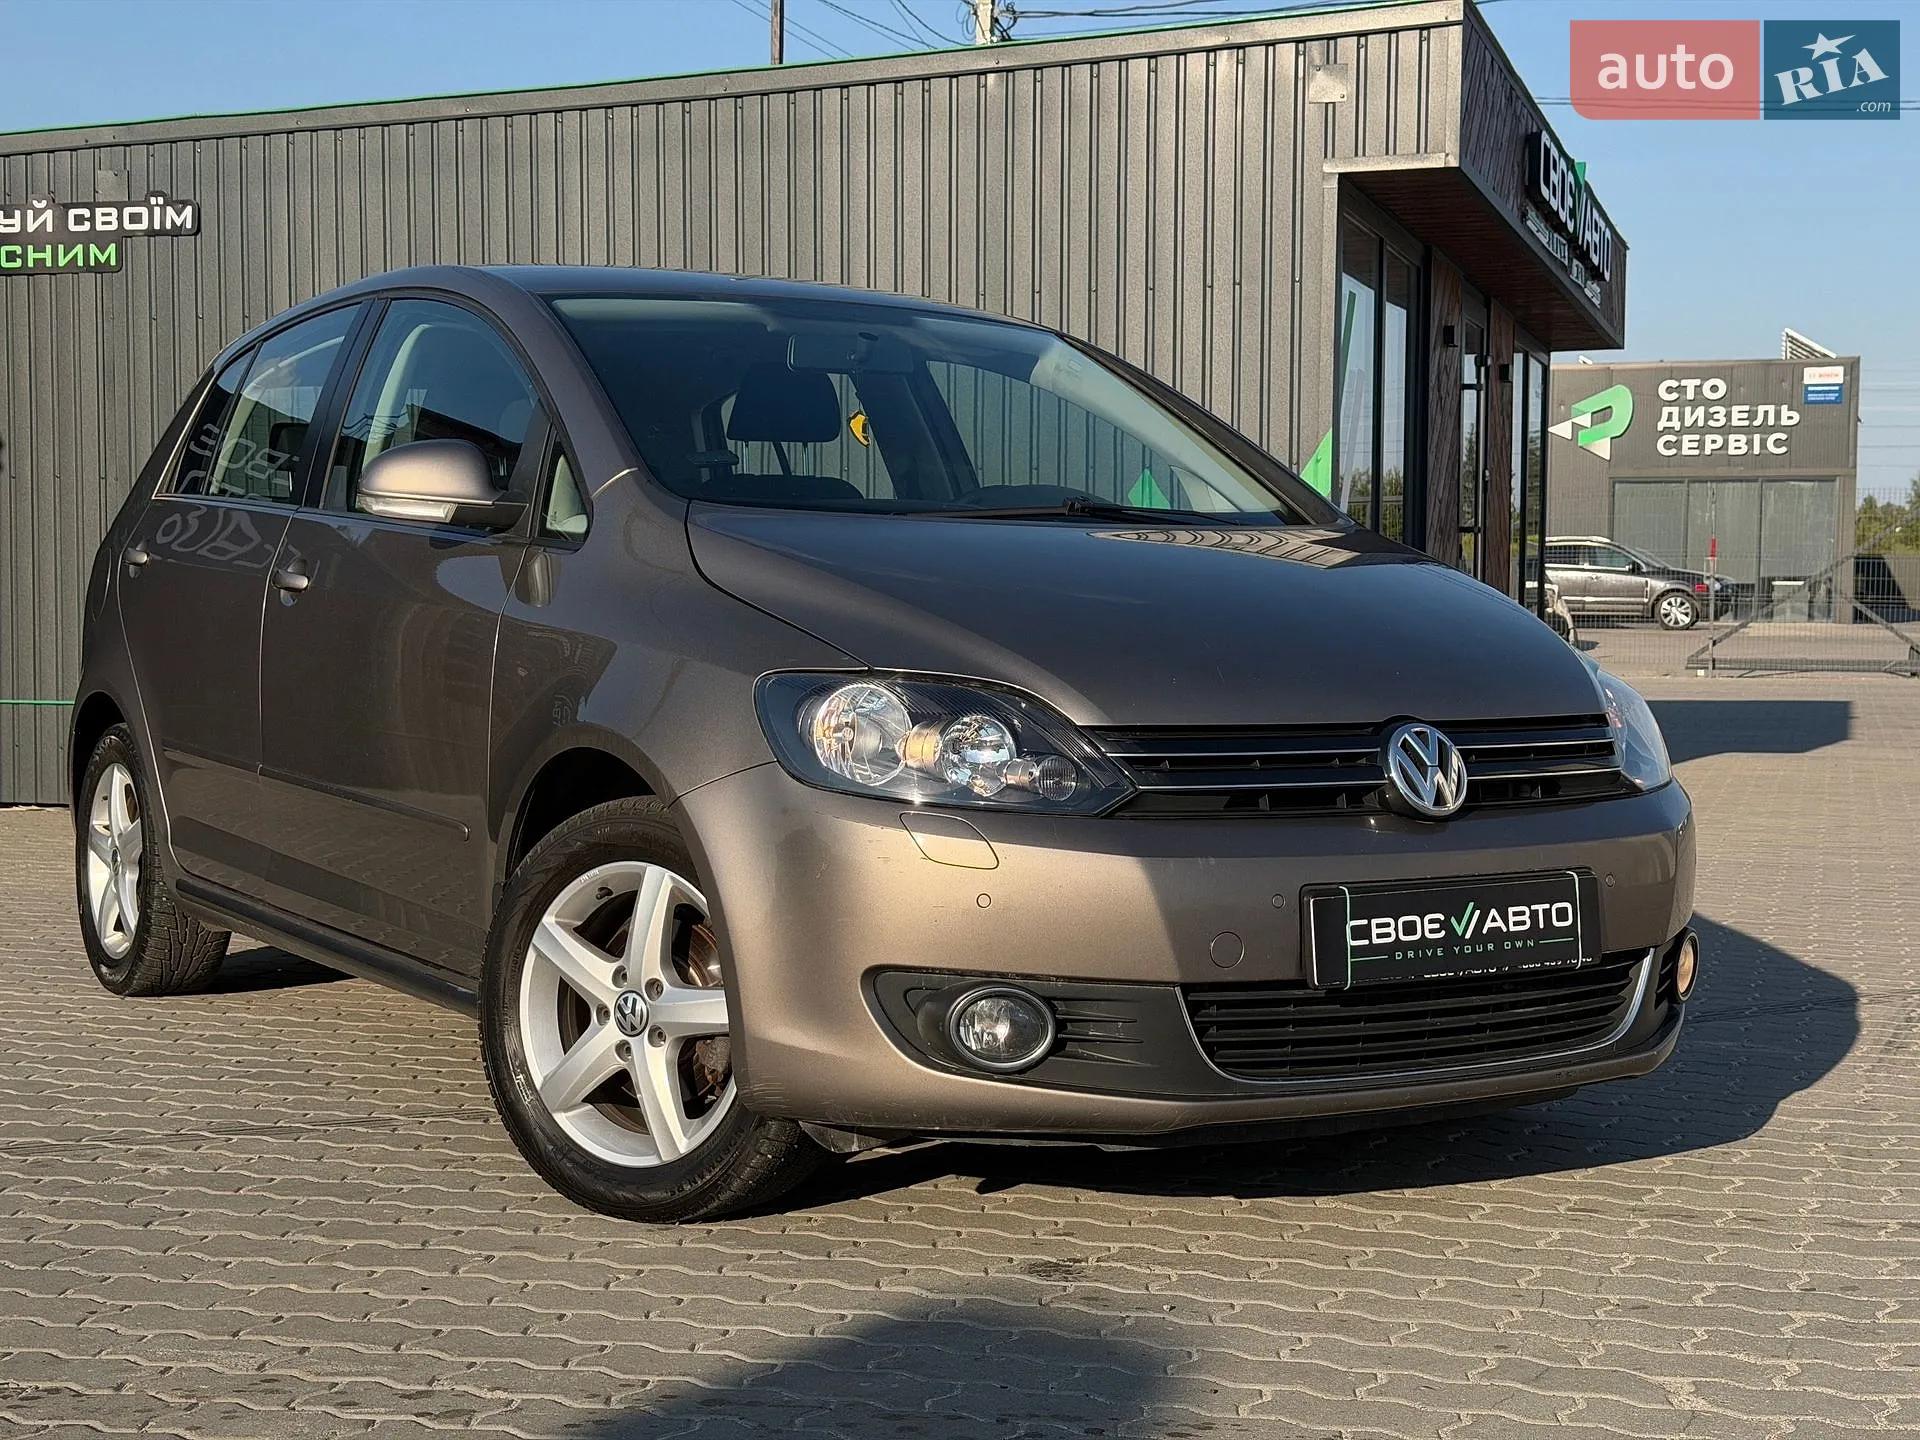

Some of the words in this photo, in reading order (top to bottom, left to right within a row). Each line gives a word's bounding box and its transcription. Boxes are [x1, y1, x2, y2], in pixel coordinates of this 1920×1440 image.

[67, 196, 193, 232] СВОЇМ
[0, 243, 117, 269] СНИМ
[1657, 378, 1728, 402] СТО
[1657, 404, 1801, 432] ДИЗЕЛЬ
[1656, 432, 1789, 457] СЕРВІС
[1395, 947, 1444, 960] DRIVE
[1453, 943, 1495, 955] YOUR
[1504, 939, 1535, 950] OWN
